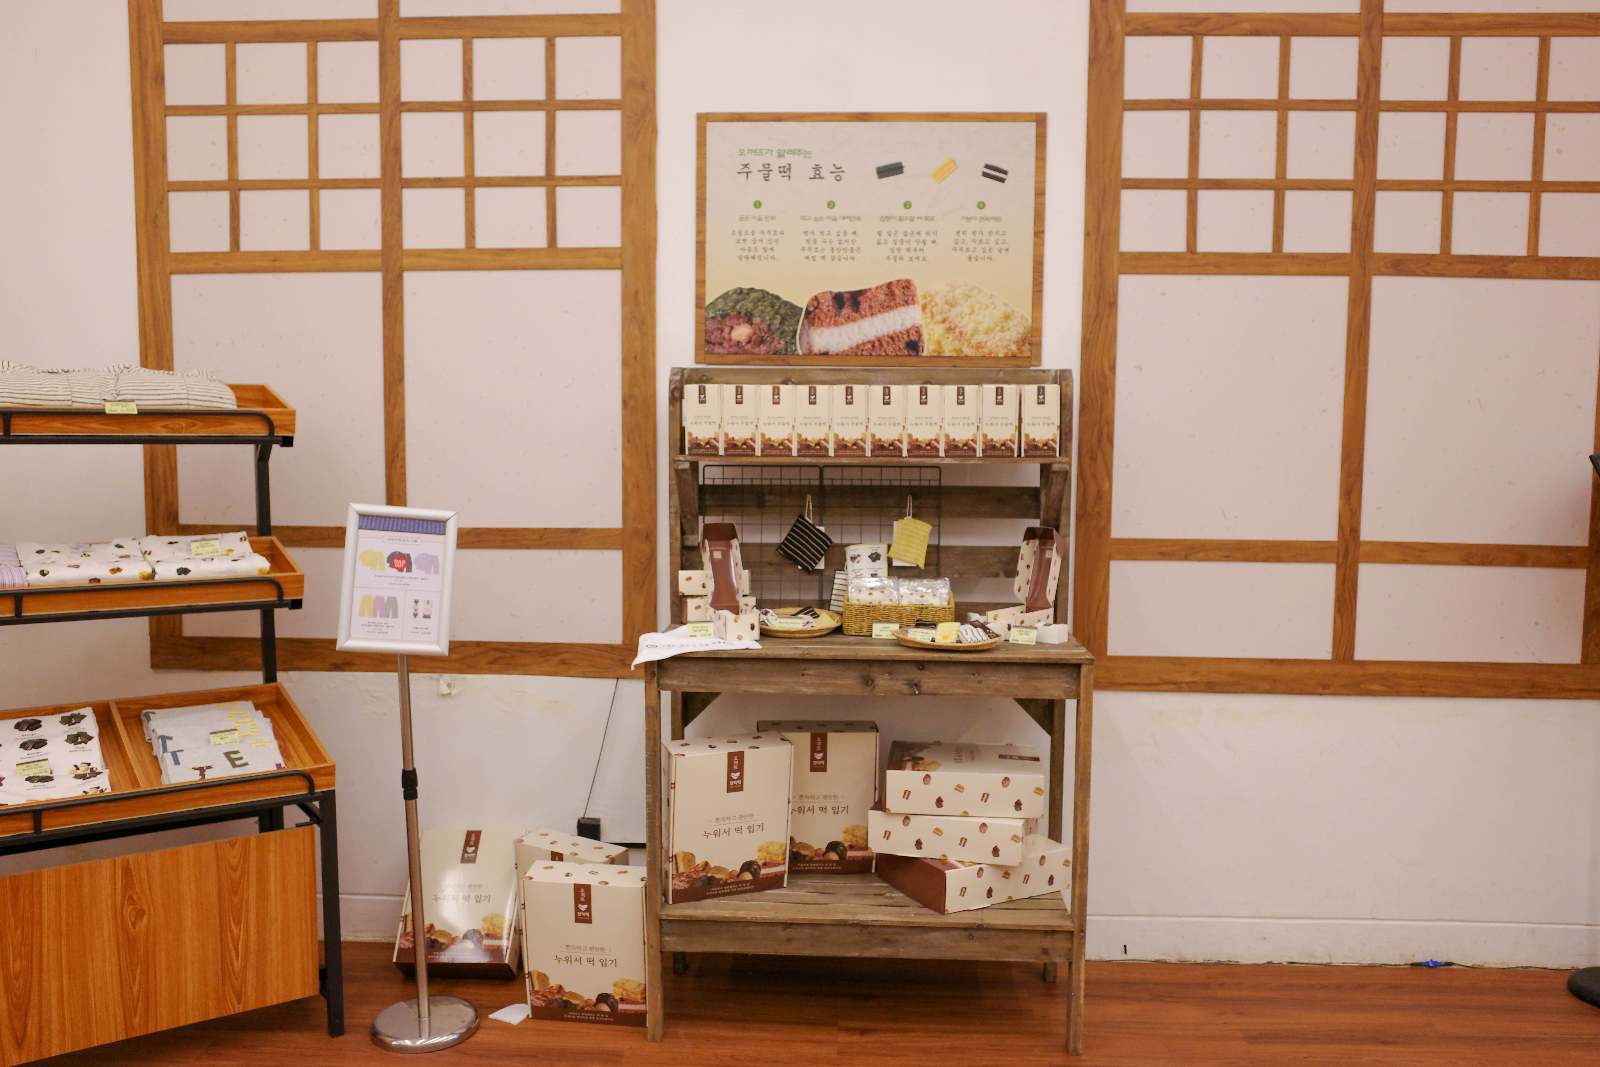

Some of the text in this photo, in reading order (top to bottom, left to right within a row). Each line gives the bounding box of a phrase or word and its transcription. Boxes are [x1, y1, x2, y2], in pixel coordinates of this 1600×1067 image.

[777, 148, 812, 158] 알려주는
[737, 162, 845, 181] 주물떡 효능
[702, 827, 731, 840] 누워서
[746, 822, 764, 835] 입기
[554, 954, 582, 966] 누워서
[598, 957, 618, 968] 입기
